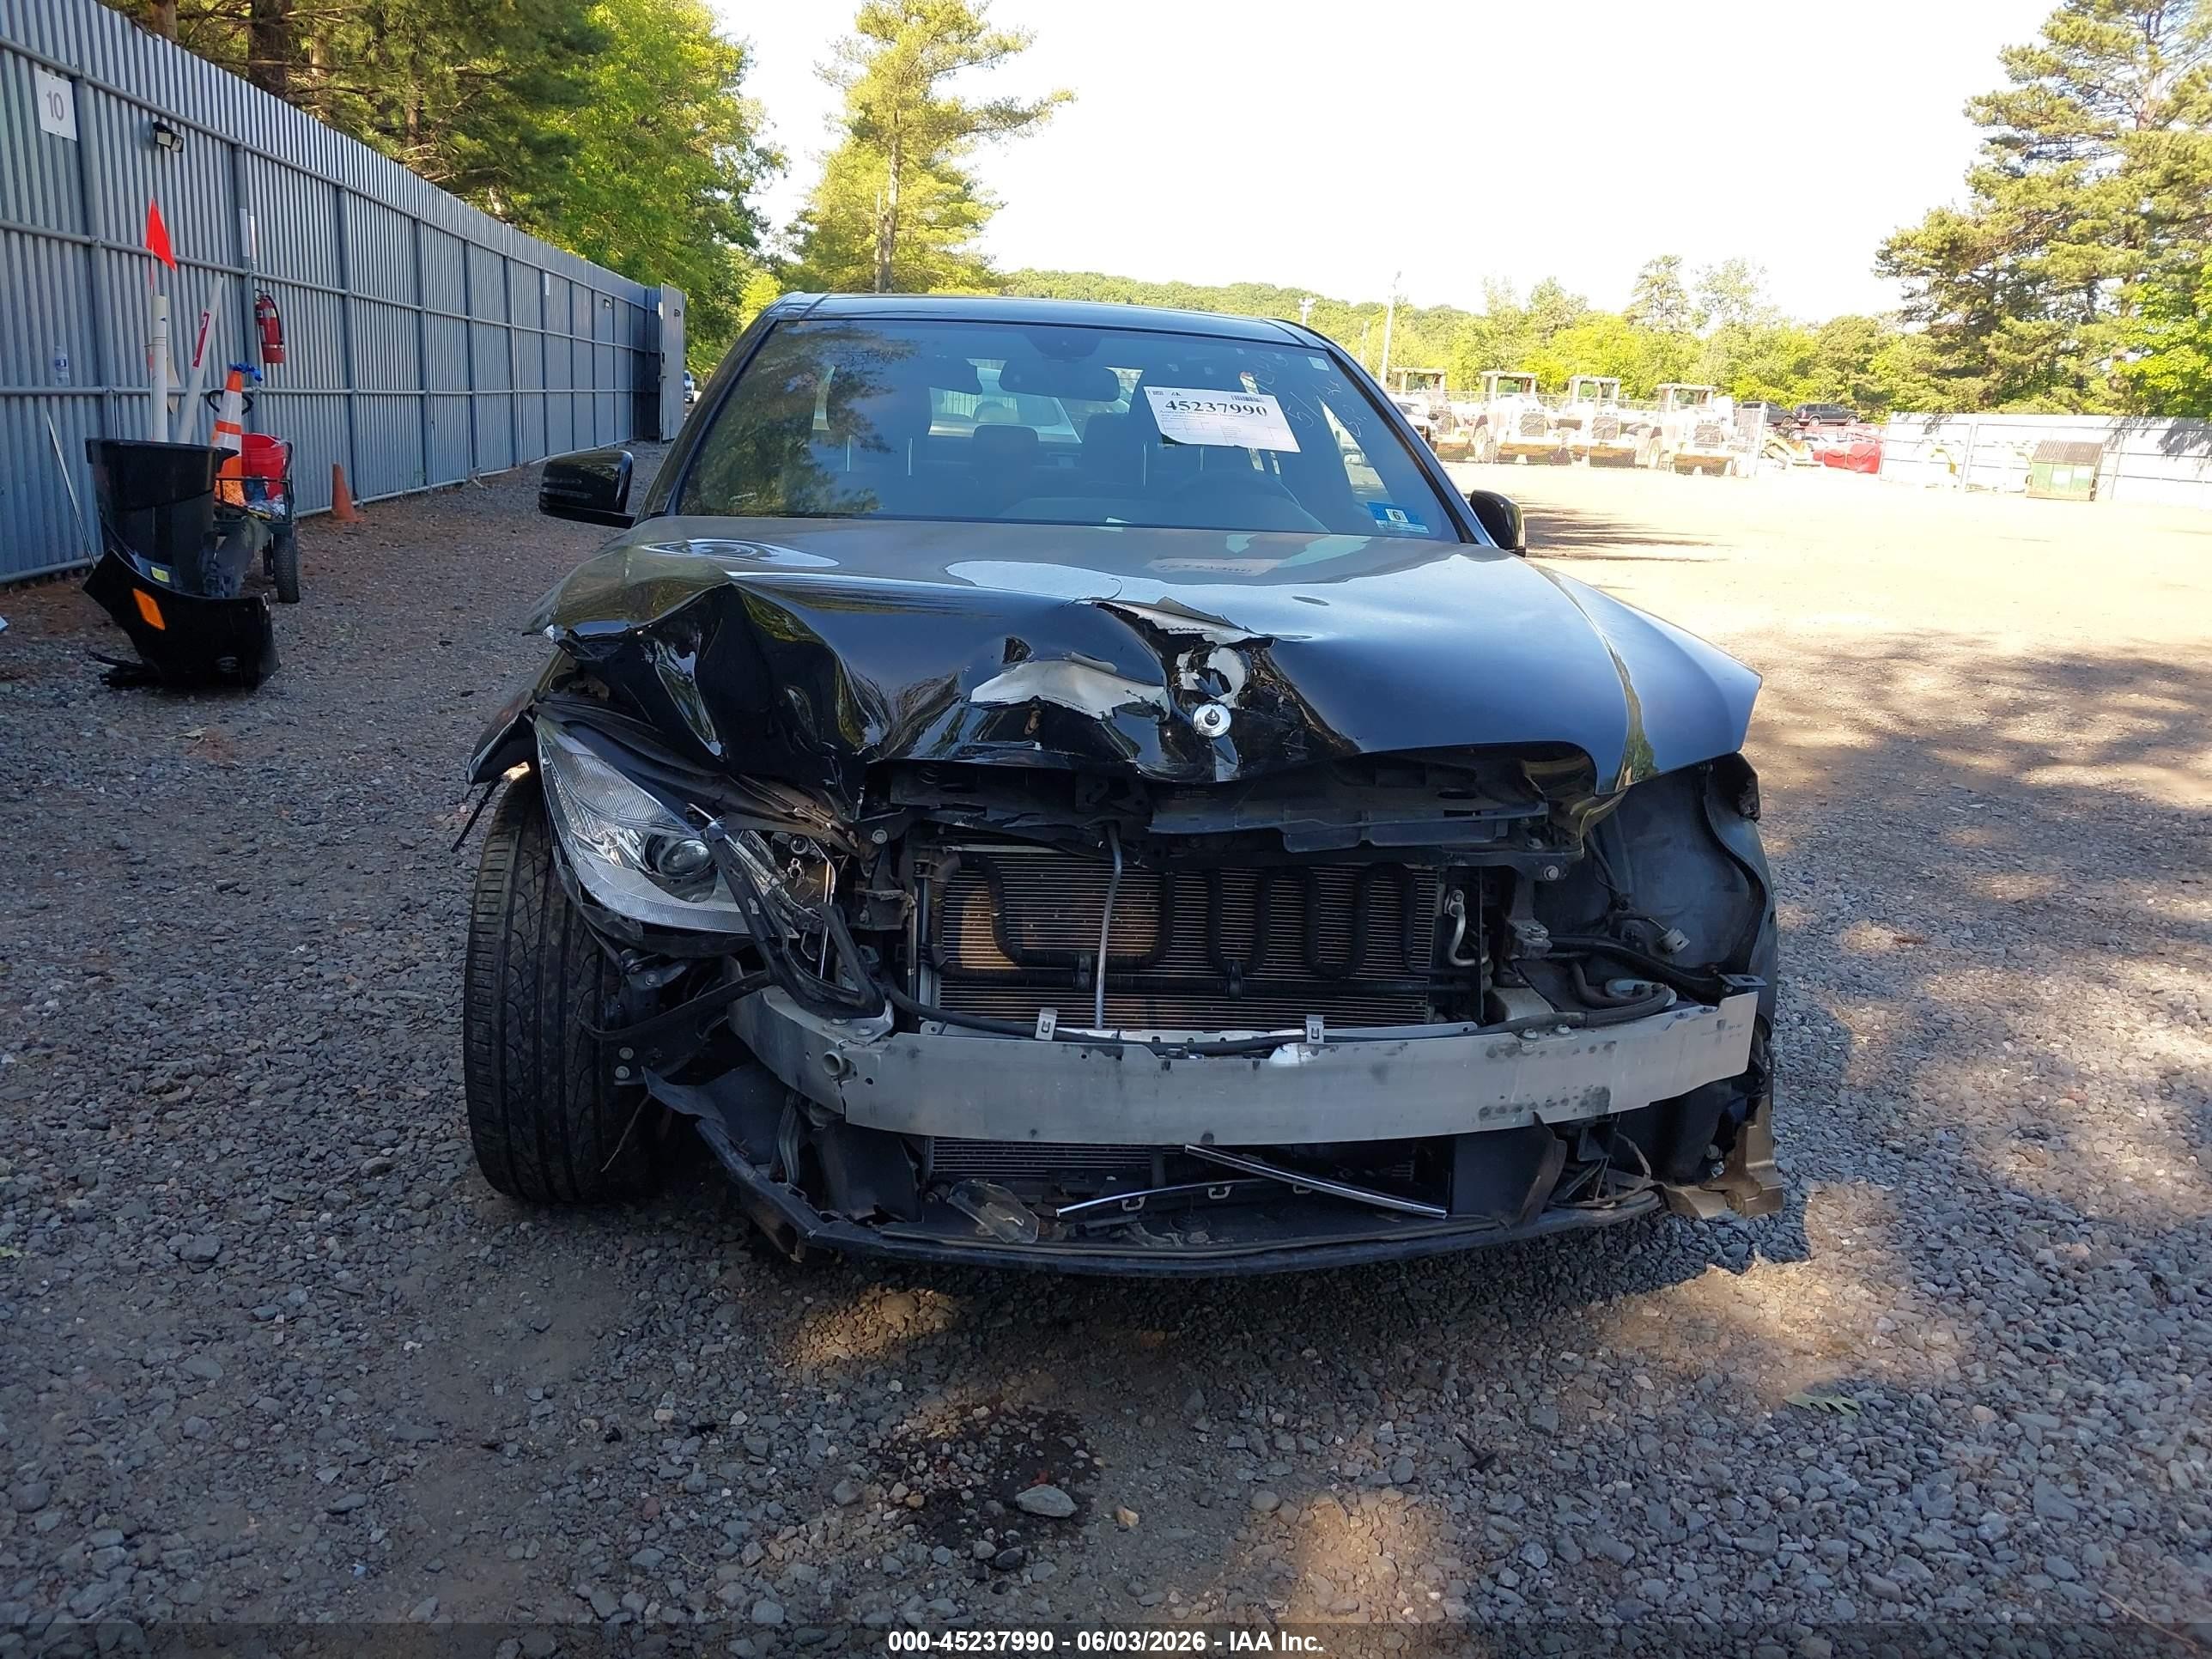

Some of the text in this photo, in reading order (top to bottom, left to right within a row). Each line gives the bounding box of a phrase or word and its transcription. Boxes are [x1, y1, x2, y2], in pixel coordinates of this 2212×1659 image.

[46, 90, 64, 121] 10
[1165, 399, 1267, 417] 45237990
[1393, 511, 1401, 520] 6
